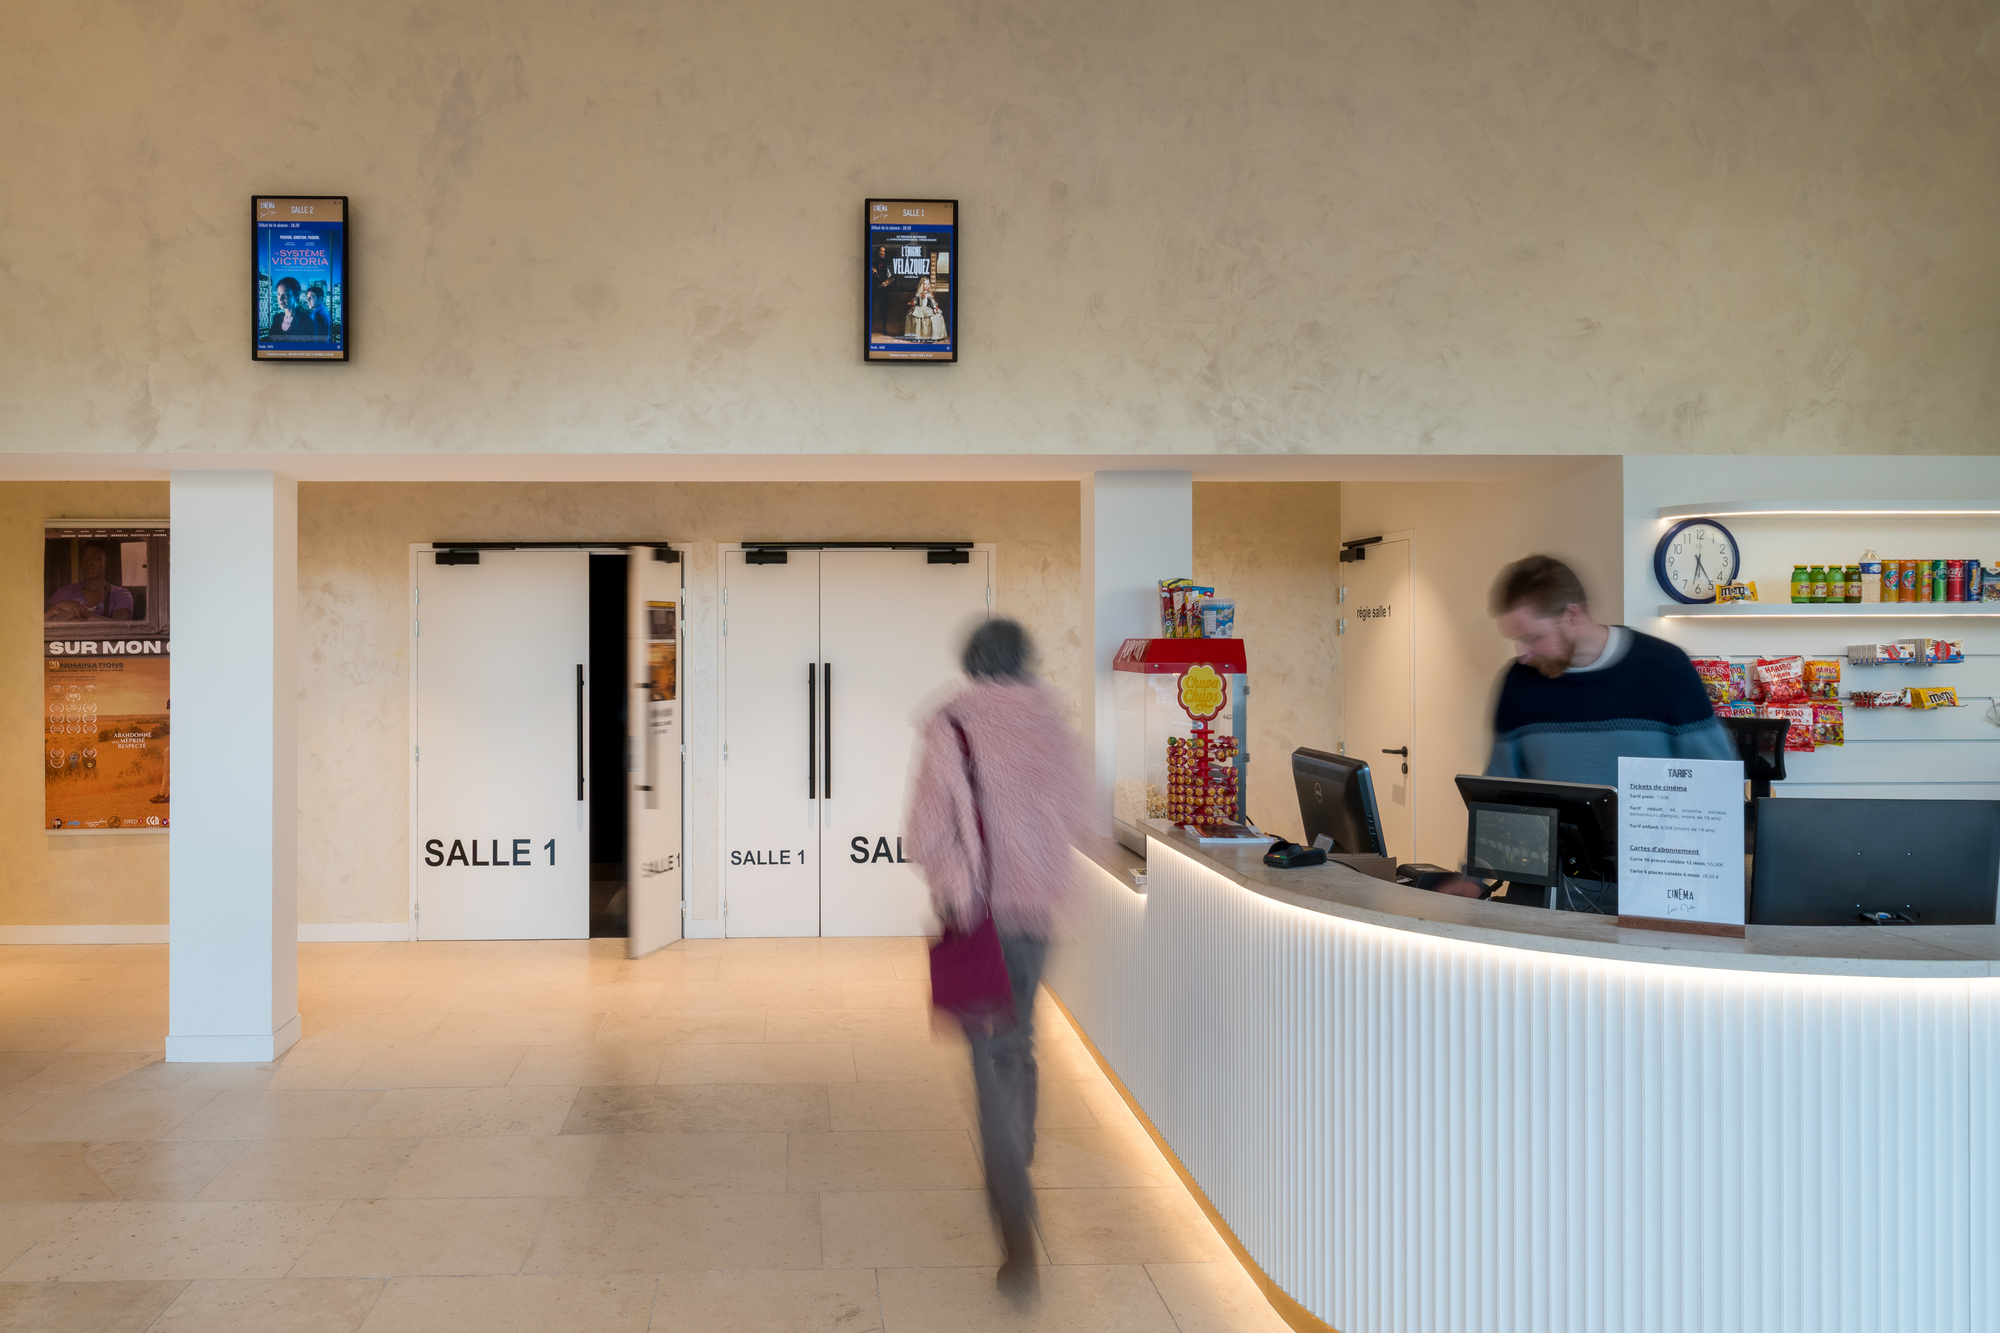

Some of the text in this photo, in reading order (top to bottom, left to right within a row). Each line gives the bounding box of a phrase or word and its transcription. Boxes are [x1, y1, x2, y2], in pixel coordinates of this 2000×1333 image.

[310, 206, 314, 214] 2
[903, 209, 924, 217] SALLE 1
[280, 249, 325, 257] SYSTÈME
[272, 257, 328, 265] VICTORIA
[1683, 533, 1691, 544] 11
[1696, 529, 1705, 540] 12
[1712, 534, 1715, 544] 1
[1674, 544, 1683, 554] 10
[1719, 544, 1725, 554] 2
[1669, 557, 1674, 567] 9
[1722, 557, 1728, 567] 3
[1673, 570, 1678, 580] 8
[1717, 571, 1723, 581] 4
[1683, 580, 1688, 589] 7
[1695, 584, 1701, 594] 6
[1708, 580, 1714, 591] 5
[1357, 604, 1391, 621] régie salle 1
[49, 641, 98, 655] SUR
[102, 640, 161, 654] MON
[49, 660, 60, 669] 20
[1764, 663, 1792, 673] HARIBO
[1185, 676, 1218, 692] Chupa
[1184, 689, 1218, 705] Chups
[1668, 768, 1693, 778] TARIFS
[146, 816, 160, 826] CGR
[424, 839, 555, 867] SALLE 1
[850, 836, 914, 864] SAL
[1652, 846, 1700, 855] d'abonnement
[676, 852, 680, 867] 1
[730, 850, 805, 866] SALLE 1
